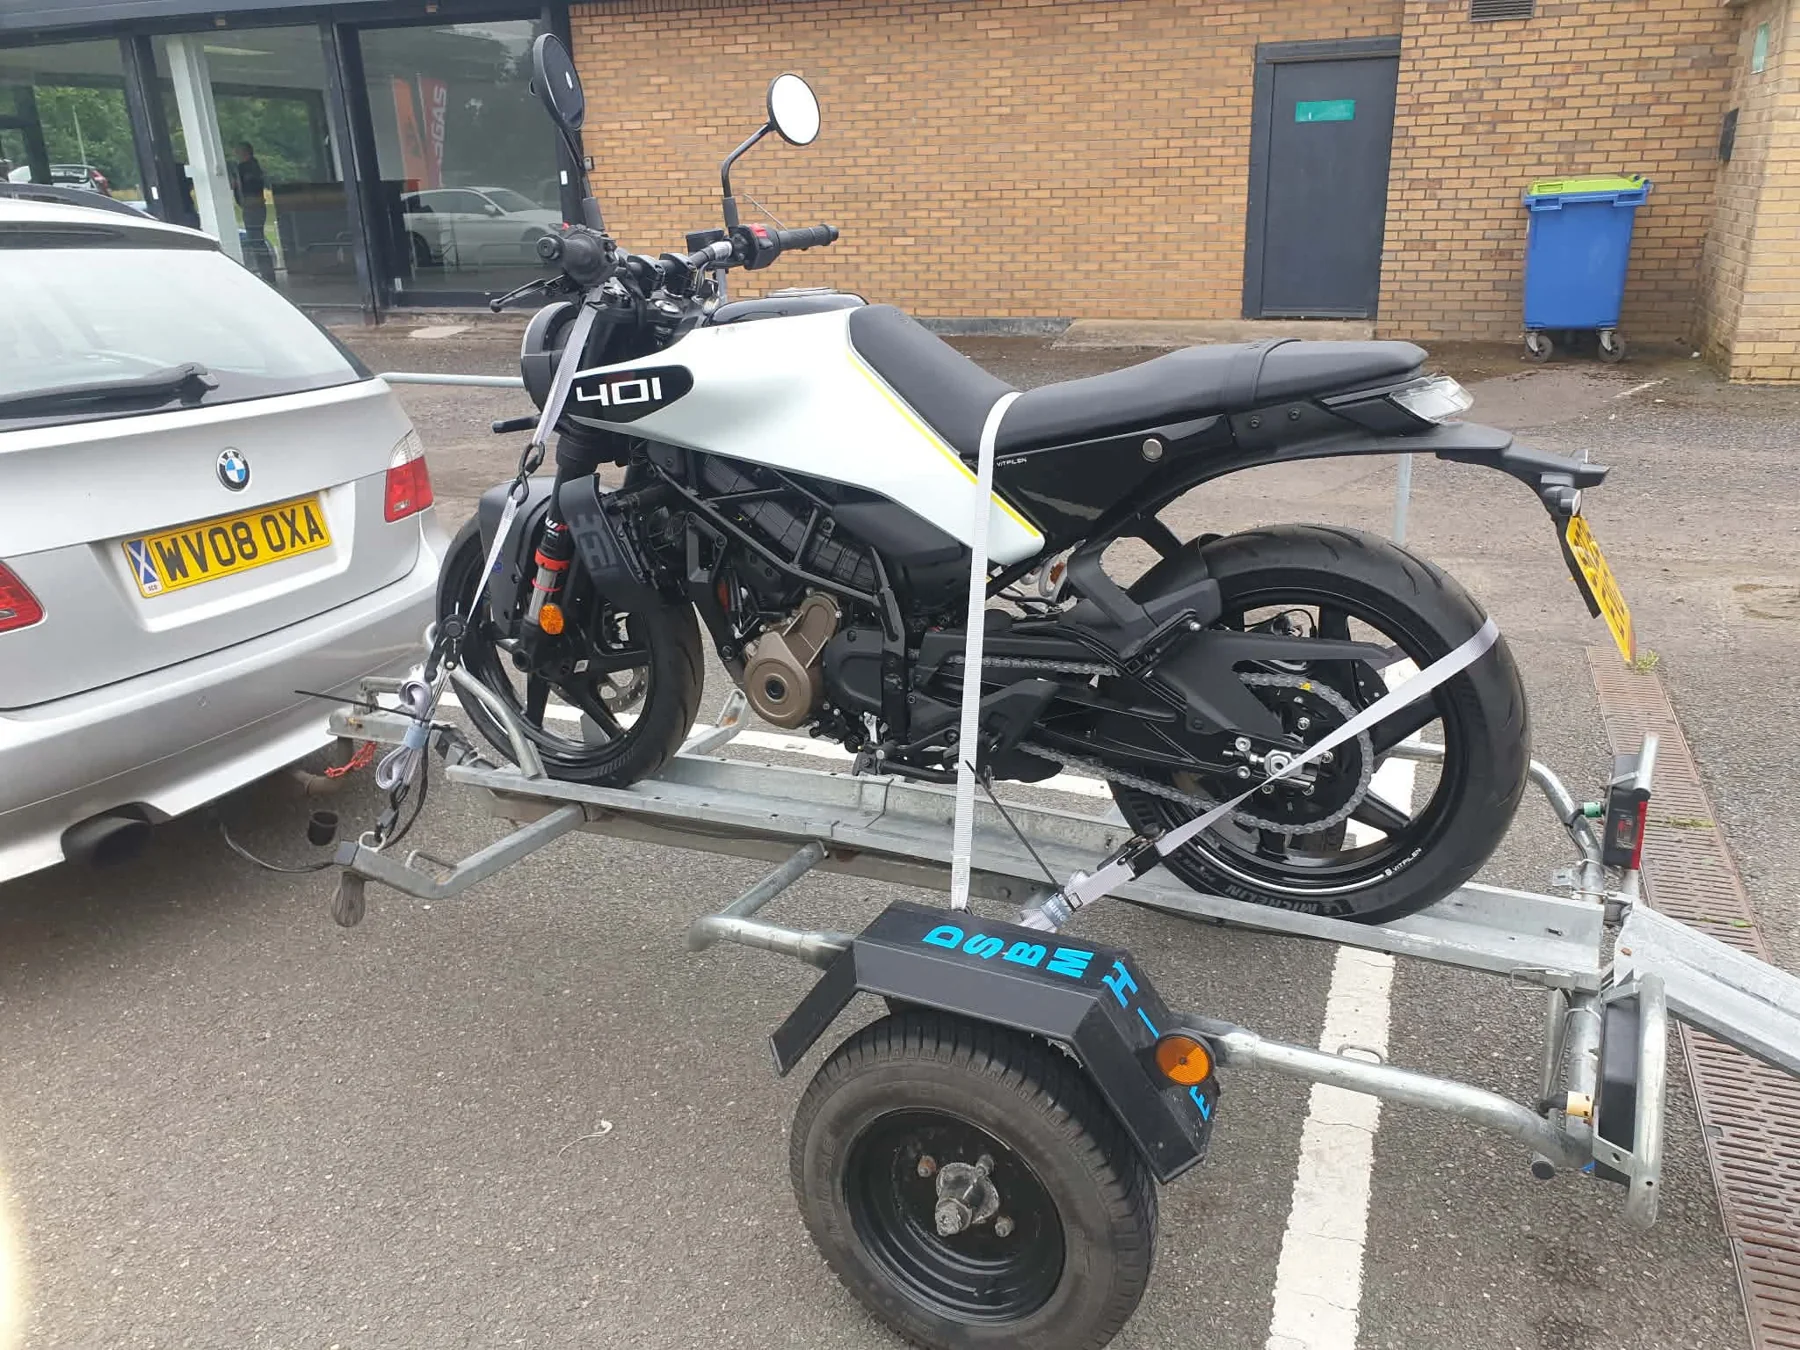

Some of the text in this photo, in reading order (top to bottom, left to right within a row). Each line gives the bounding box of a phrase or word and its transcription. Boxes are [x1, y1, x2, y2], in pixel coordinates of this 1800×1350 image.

[576, 377, 662, 406] 401
[154, 505, 325, 581] WV08 OXA
[1225, 883, 1319, 914] MICHELIN
[922, 925, 1094, 979] DSBM
